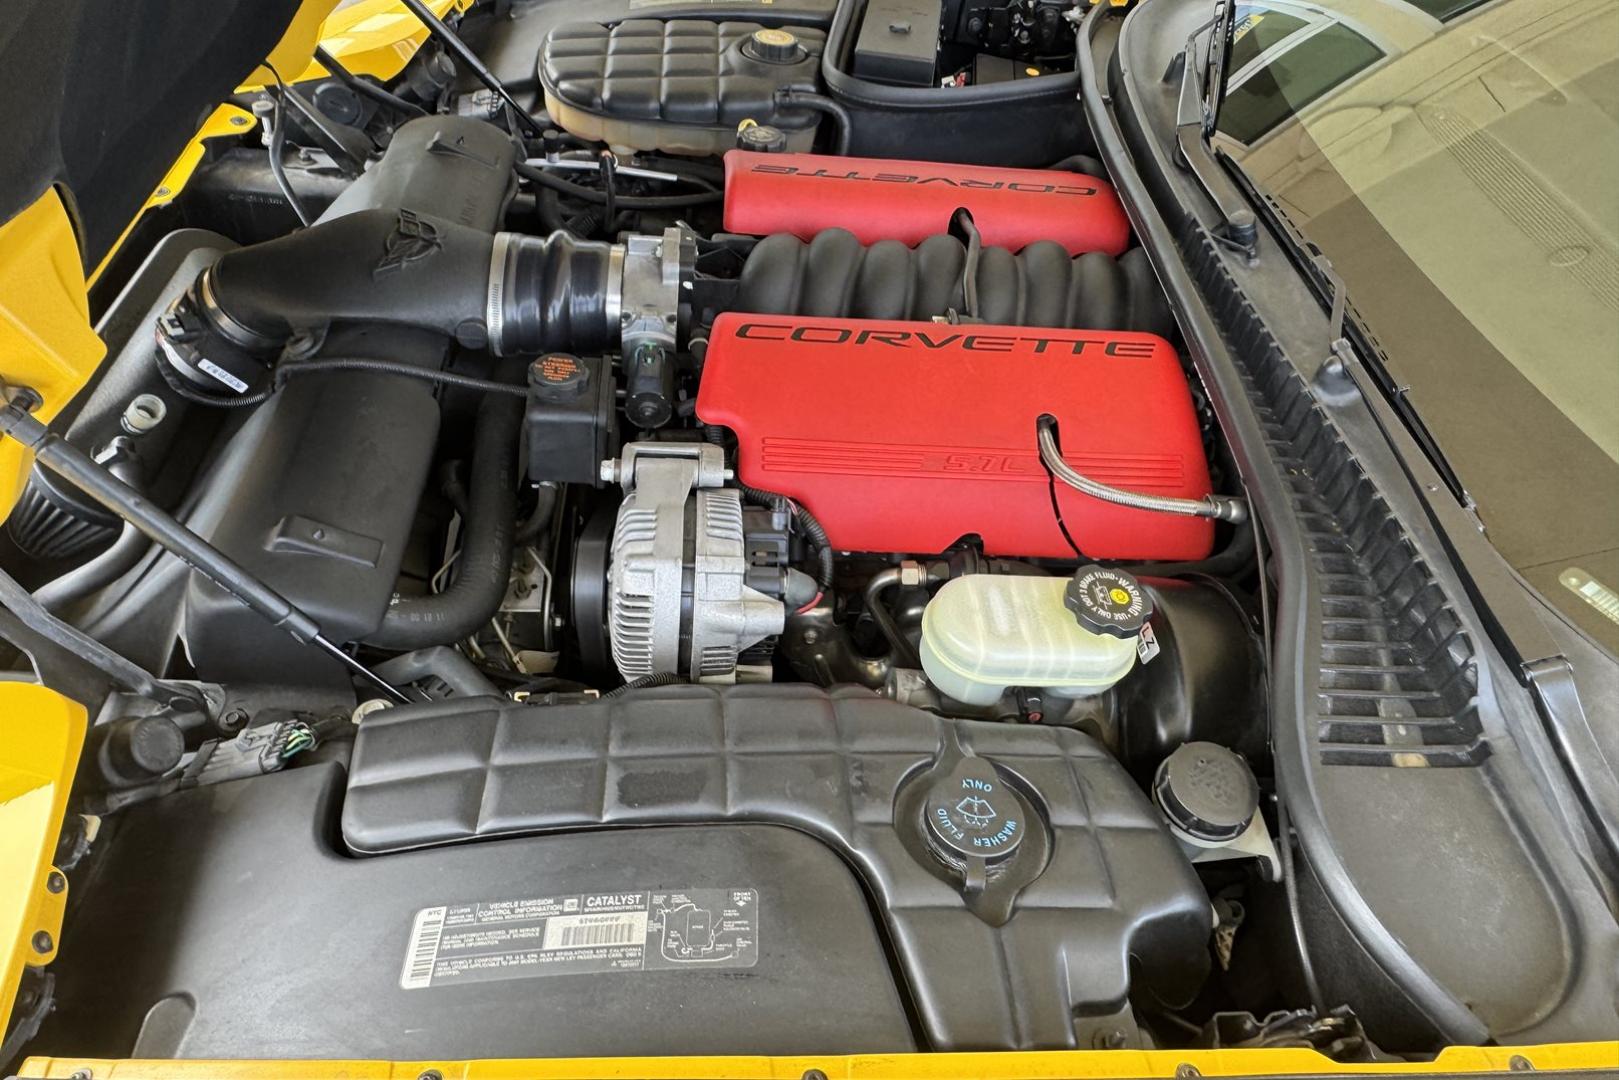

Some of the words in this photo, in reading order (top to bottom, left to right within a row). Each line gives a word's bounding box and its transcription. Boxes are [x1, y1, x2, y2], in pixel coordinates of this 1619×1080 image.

[751, 164, 1097, 196] CORVETTE
[735, 323, 1156, 359] CORVETTE
[943, 454, 1026, 473] 5.7L
[1079, 573, 1096, 589] BRAKE
[1094, 571, 1115, 581] FLUID
[1118, 577, 1143, 616] WARNING
[1091, 606, 1112, 619] ONLY
[961, 778, 992, 793] ONLY
[937, 808, 964, 840] FLUID
[973, 819, 1017, 847] WASHER
[489, 900, 519, 910] VEHICLE
[520, 898, 554, 907] EMISSION
[587, 894, 642, 906] CATALYST
[478, 909, 512, 917] CONTROL
[514, 904, 563, 914] INFORMATION
